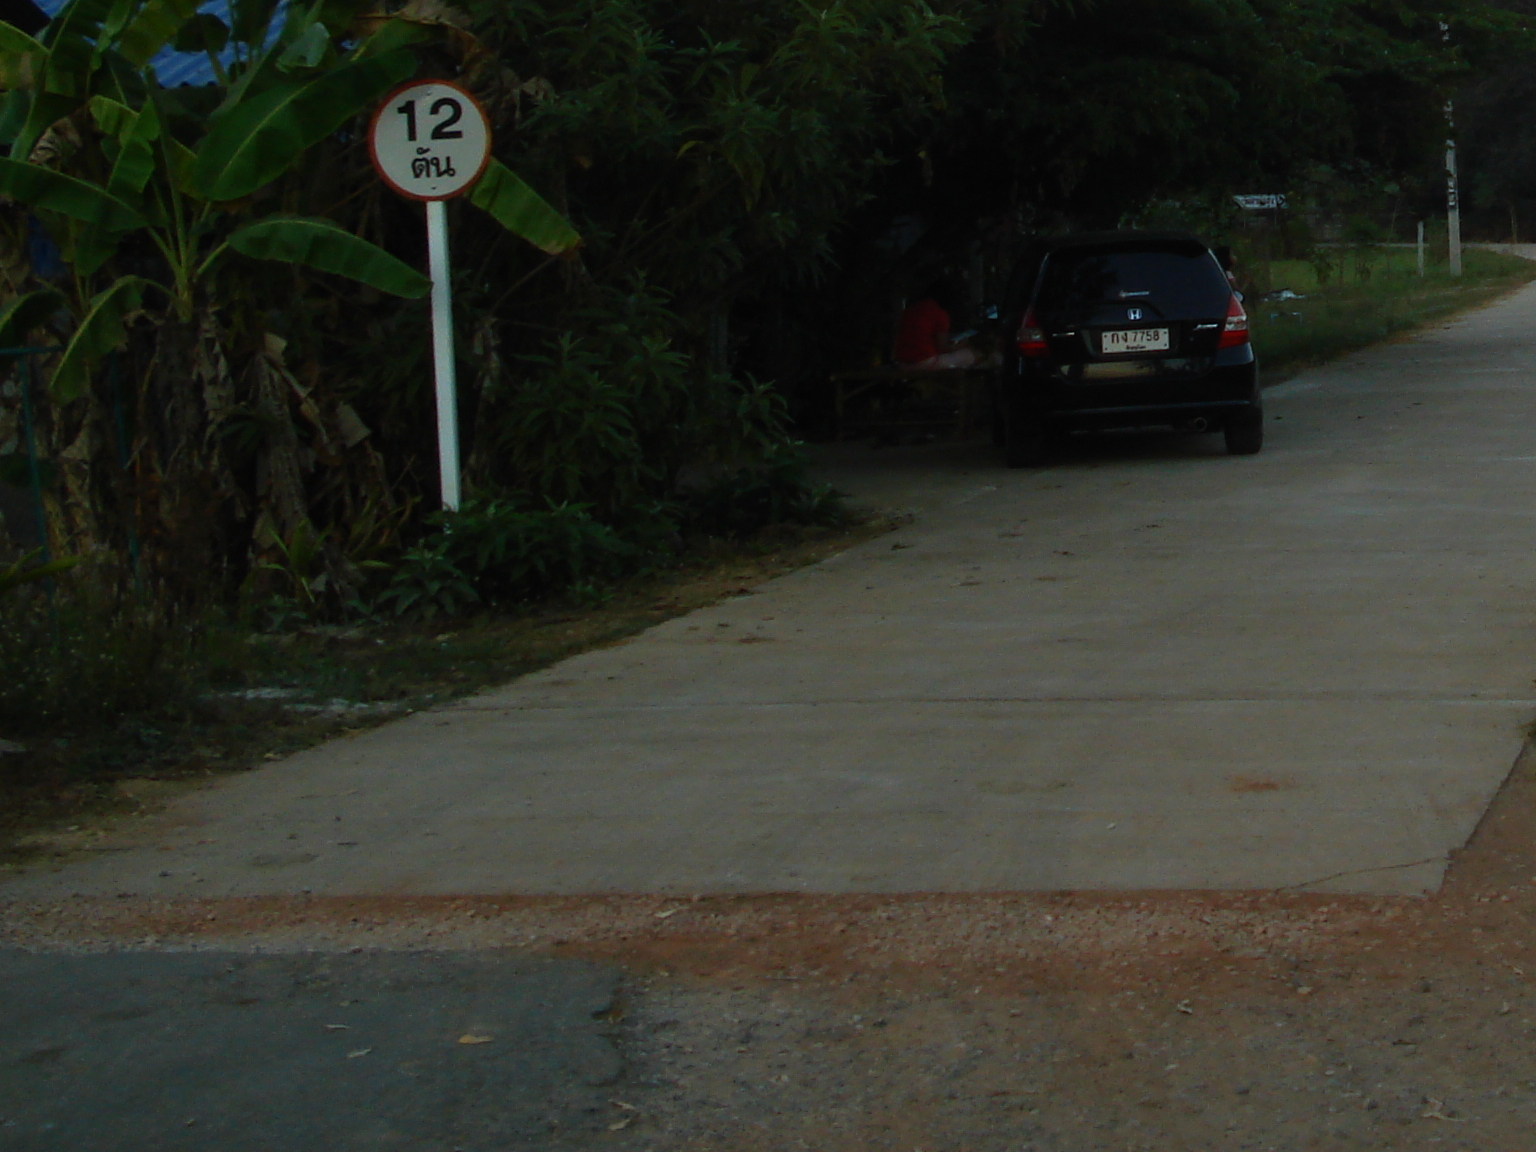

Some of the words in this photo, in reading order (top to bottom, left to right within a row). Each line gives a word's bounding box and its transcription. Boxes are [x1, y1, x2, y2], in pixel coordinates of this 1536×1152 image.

[397, 97, 463, 142] 12
[411, 146, 456, 179] ตัน
[1132, 330, 1160, 342] 7758
